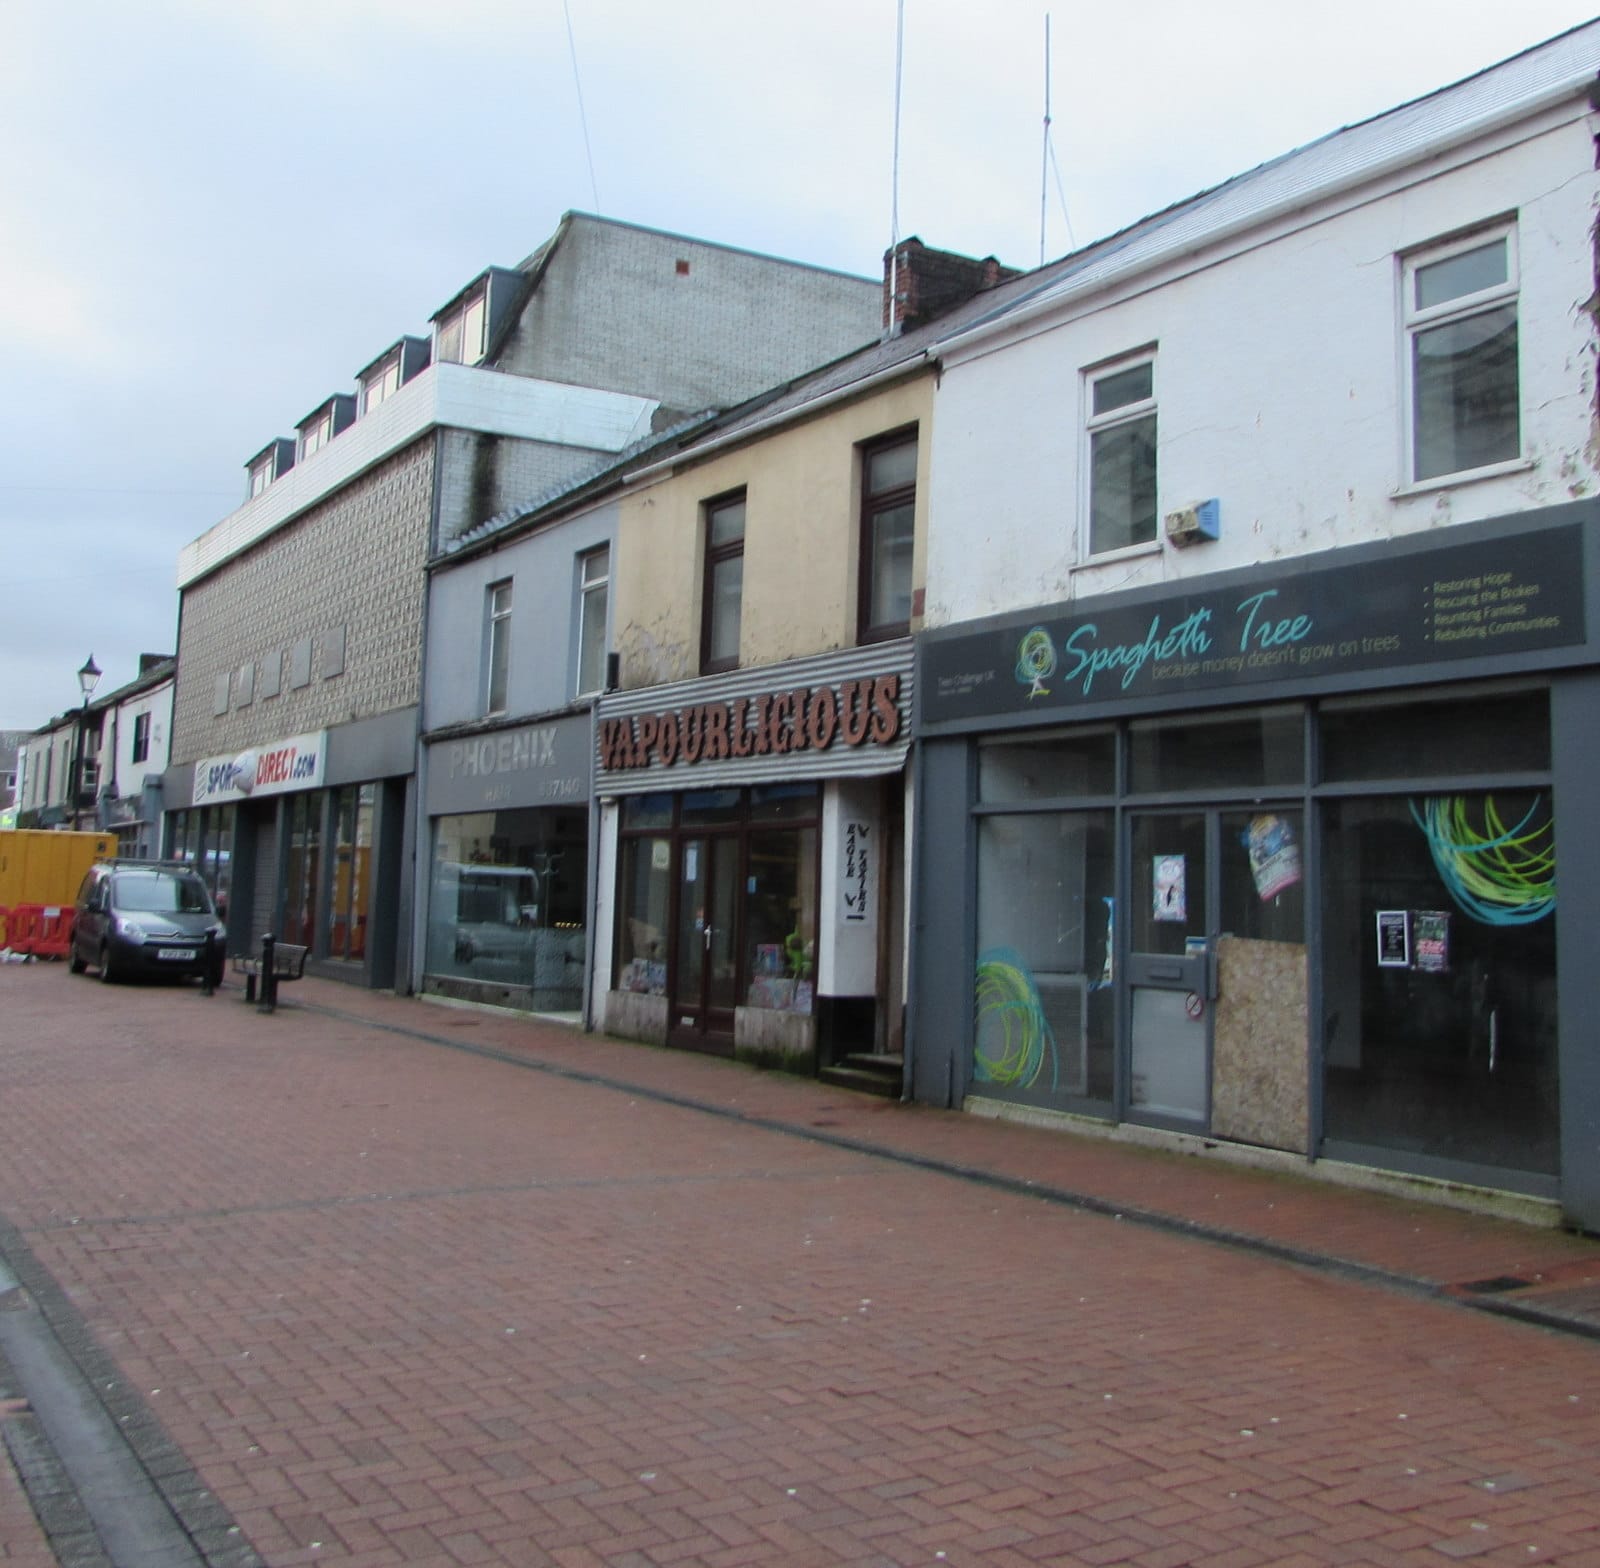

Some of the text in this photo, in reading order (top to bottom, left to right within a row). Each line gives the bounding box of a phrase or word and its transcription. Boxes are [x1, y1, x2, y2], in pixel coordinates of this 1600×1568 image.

[1434, 571, 1512, 593] Restoring Hope
[1434, 584, 1540, 609] Rescuing the Broken
[1236, 589, 1313, 653] Tree
[1484, 603, 1527, 618] Families
[1434, 616, 1561, 641] Rebuilding Communities
[1152, 634, 1400, 680] because money doesn't grow on trees
[601, 675, 899, 770] VAPOURLICIOUS
[450, 727, 558, 778] PHOENIX
